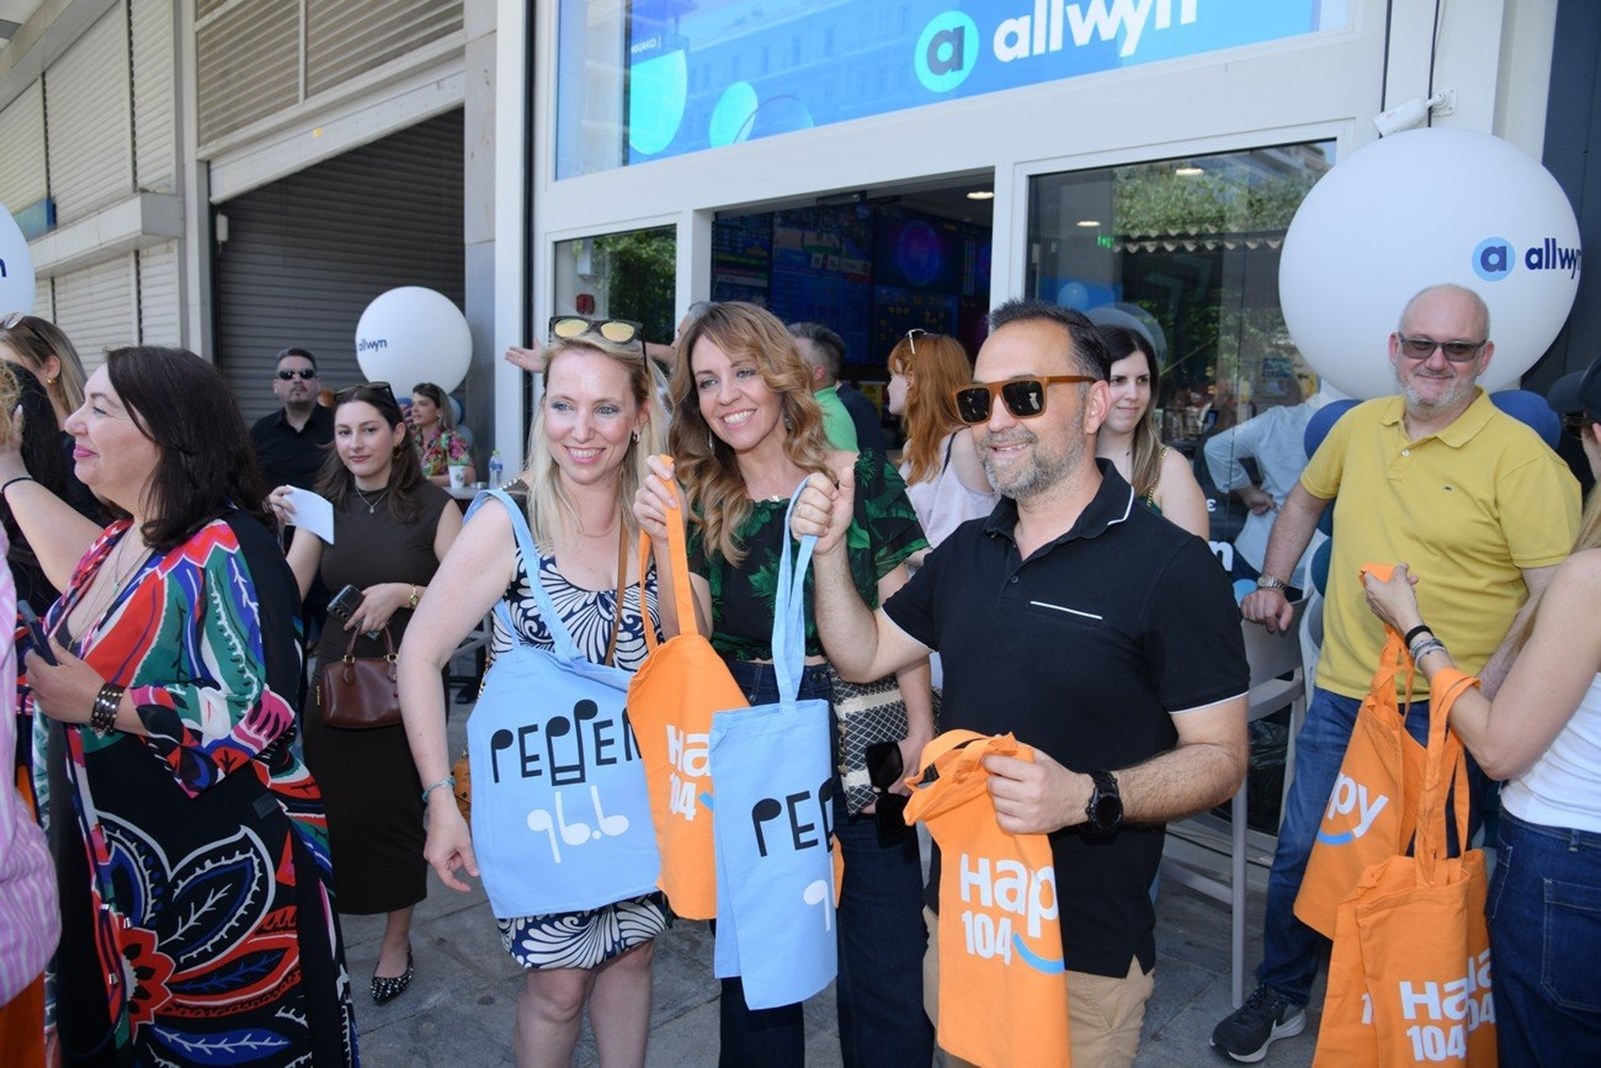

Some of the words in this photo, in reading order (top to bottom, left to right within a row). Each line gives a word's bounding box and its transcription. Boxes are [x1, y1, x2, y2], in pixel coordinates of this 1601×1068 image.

[993, 0, 1198, 63] allwyn
[961, 910, 1013, 966] 104
[1406, 1024, 1467, 1062] 104
